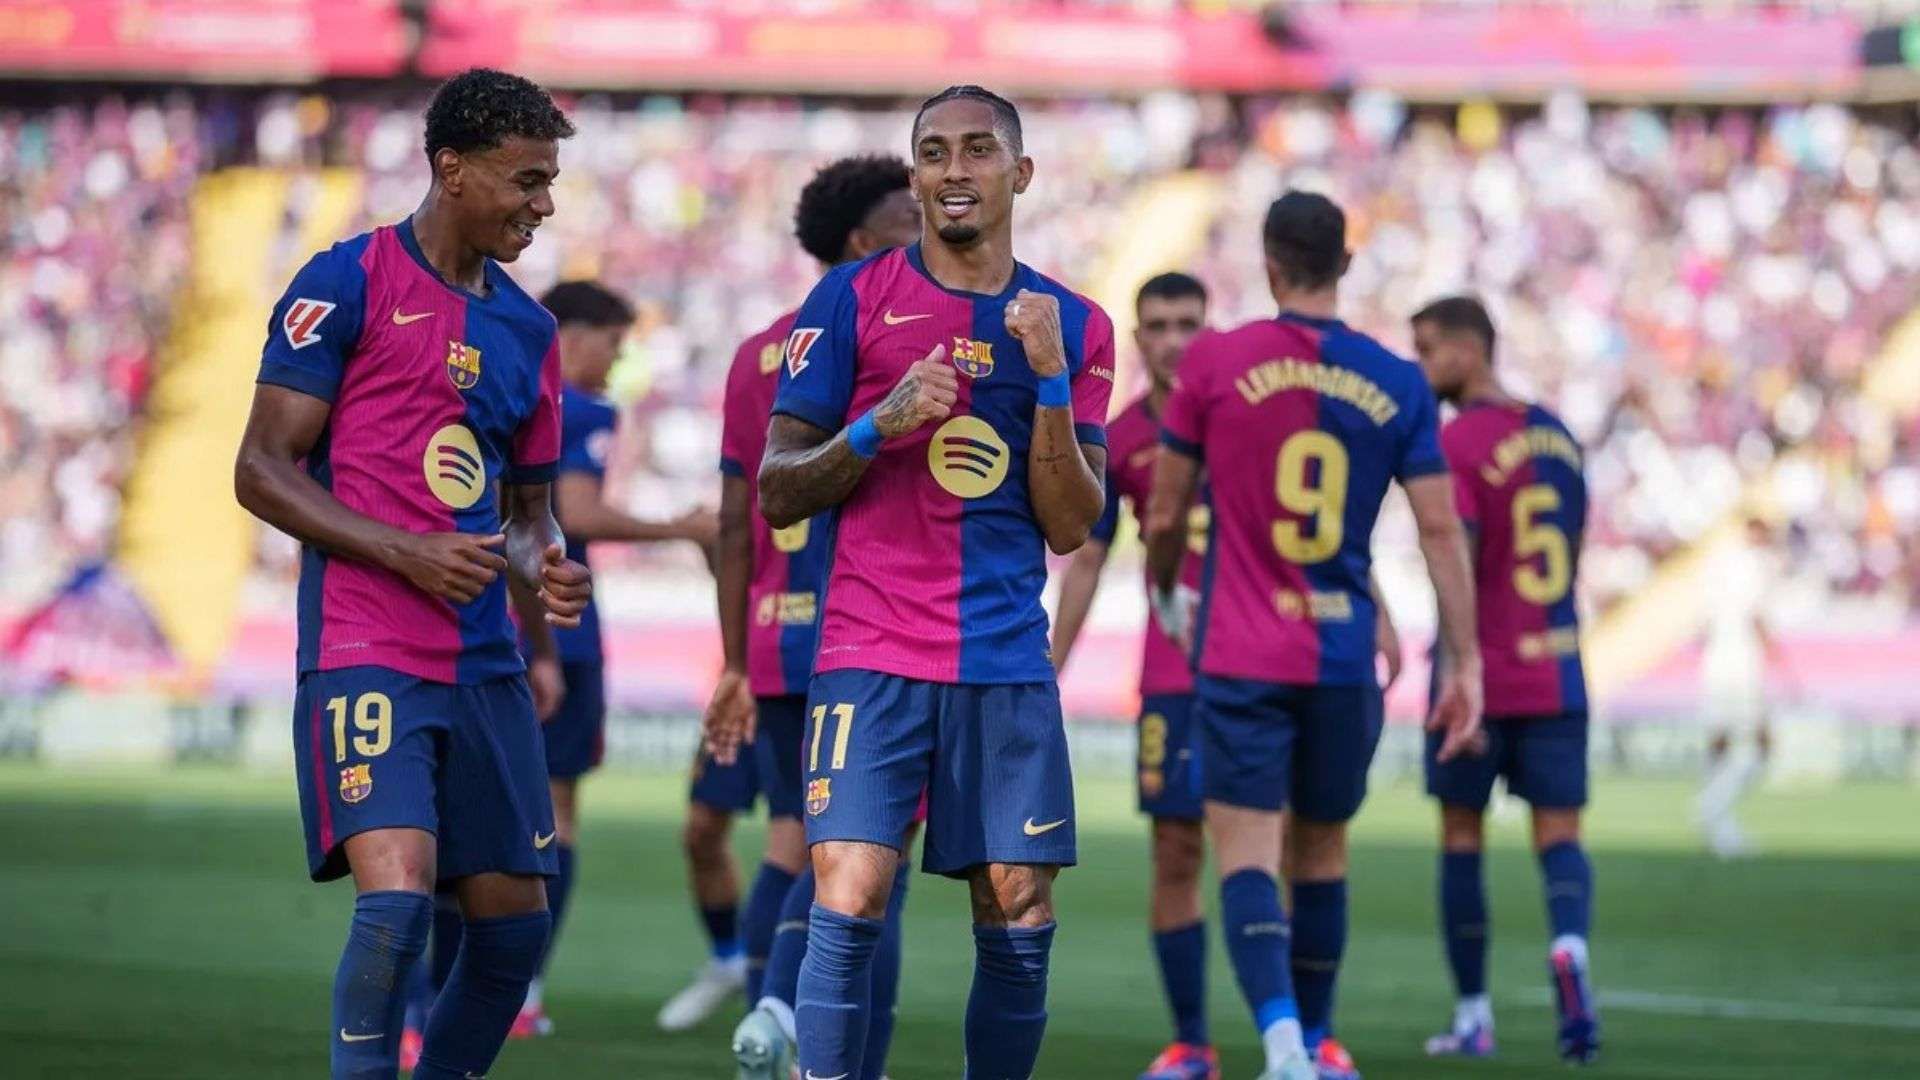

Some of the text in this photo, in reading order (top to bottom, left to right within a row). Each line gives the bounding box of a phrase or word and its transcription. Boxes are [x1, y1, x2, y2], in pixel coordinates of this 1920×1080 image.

[1272, 429, 1349, 565] 9
[1511, 484, 1572, 605] 5
[326, 691, 393, 763] 19
[811, 703, 855, 772] 11
